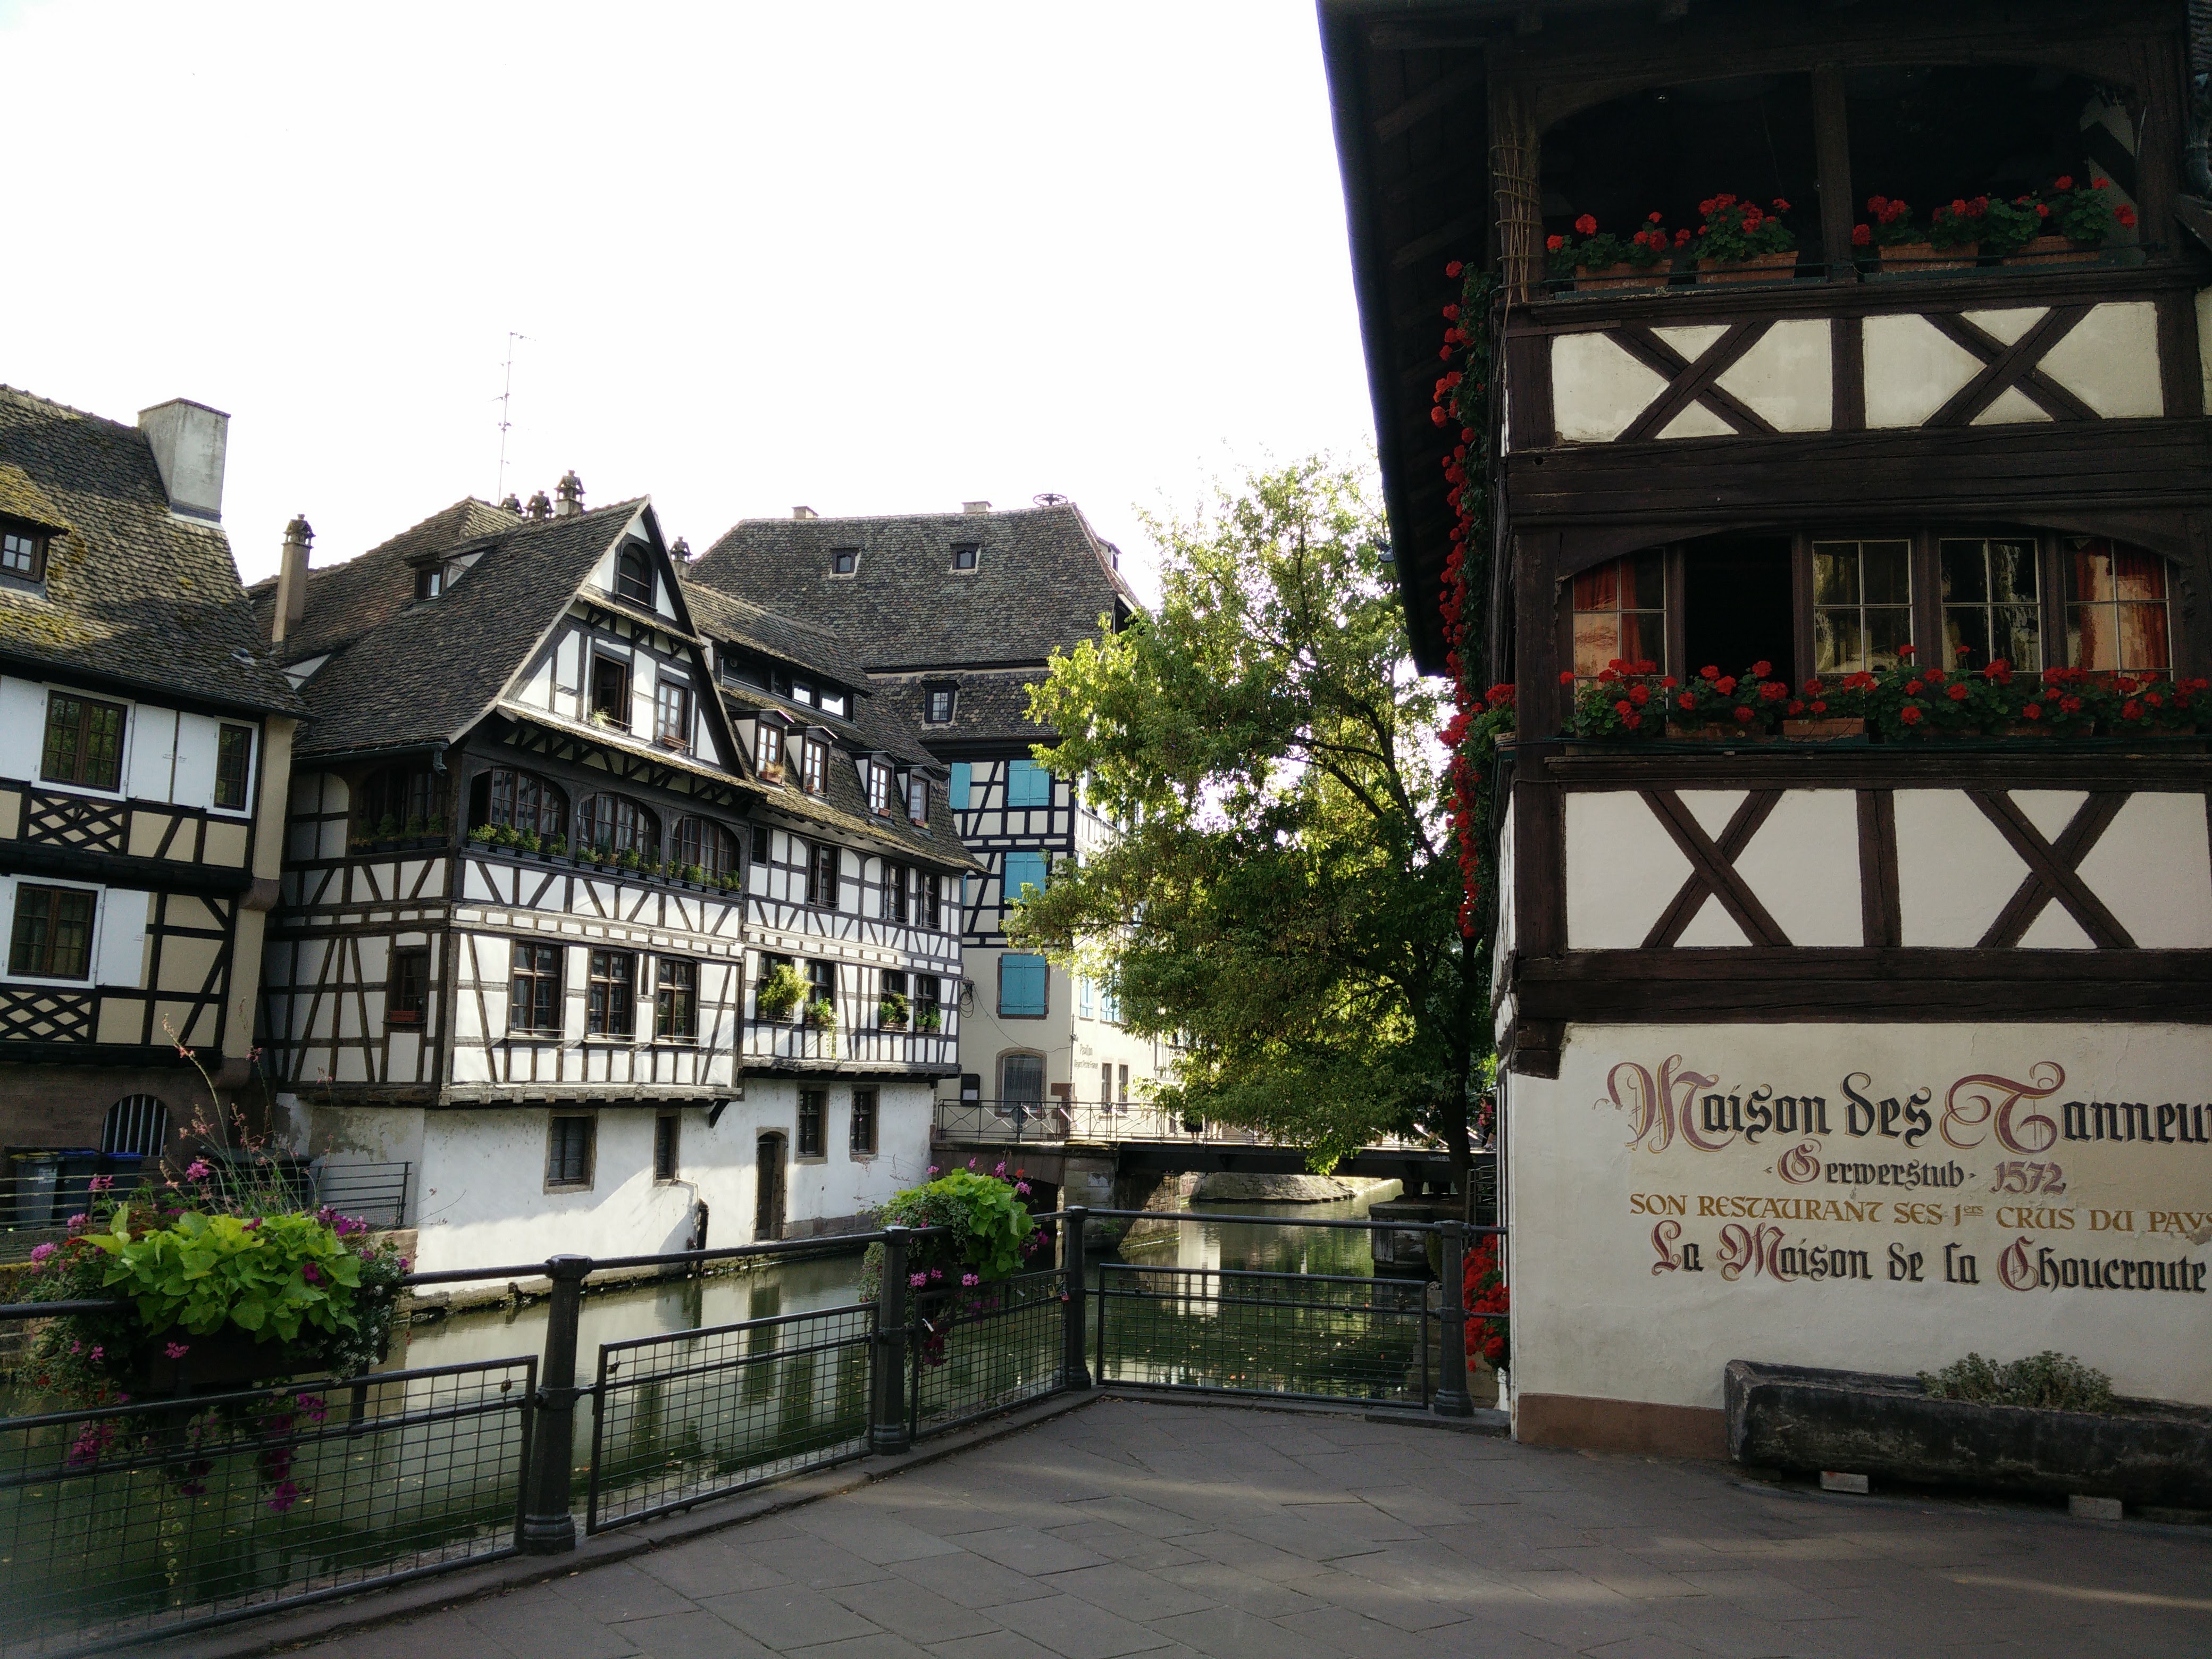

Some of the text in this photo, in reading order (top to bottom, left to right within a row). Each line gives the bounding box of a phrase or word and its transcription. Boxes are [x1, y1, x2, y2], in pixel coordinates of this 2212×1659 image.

[1592, 1054, 2212, 1155] Maison des Tanneu
[1989, 1161, 2066, 1196] 1572
[1630, 1193, 1688, 1216] SON
[1697, 1194, 1884, 1223] RESTAURANT
[1893, 1201, 1943, 1226] SES
[1996, 1205, 2075, 1230] CRUS
[2088, 1209, 2135, 1233] DU
[1651, 1219, 2207, 1294] La Maison de la Choucroute
